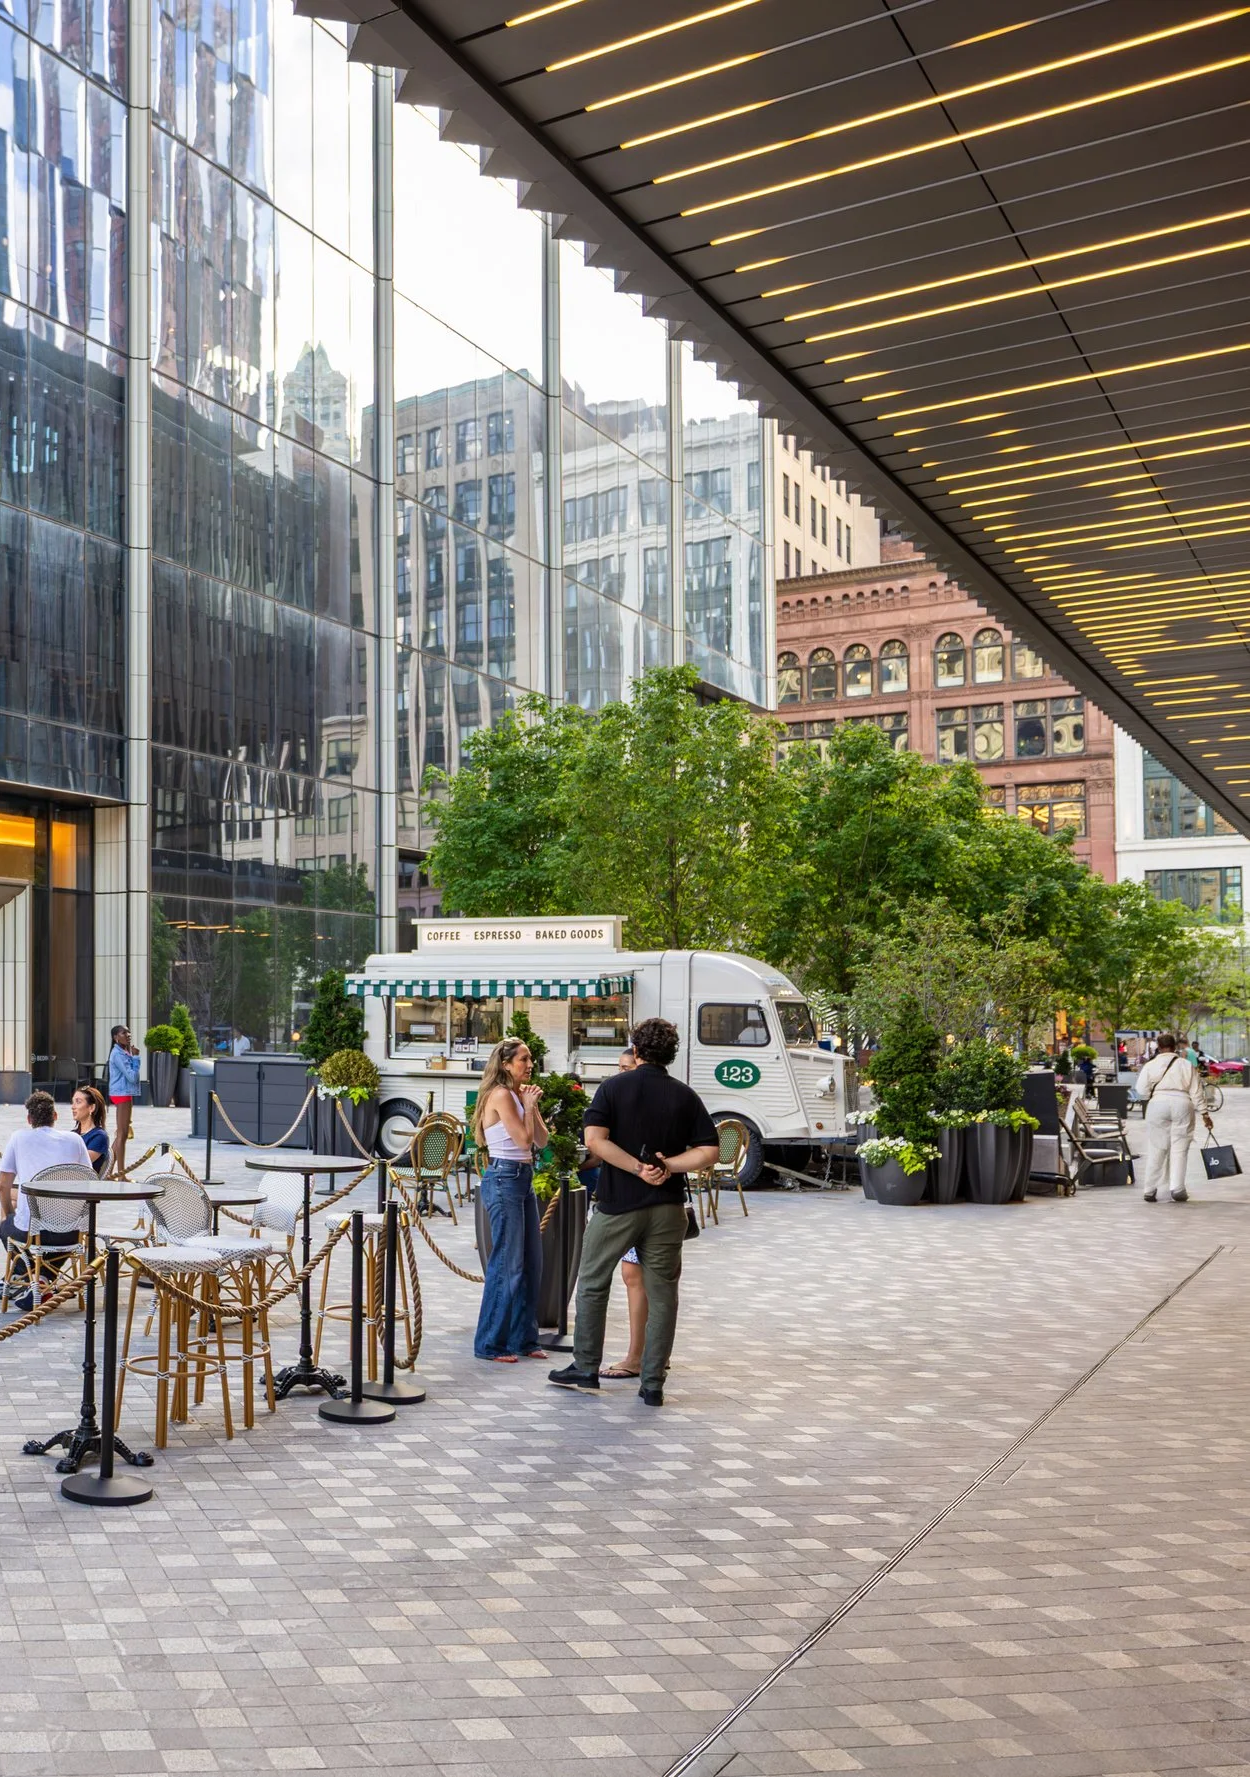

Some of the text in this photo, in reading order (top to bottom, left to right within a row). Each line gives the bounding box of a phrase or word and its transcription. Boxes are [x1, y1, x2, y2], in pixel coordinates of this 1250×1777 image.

[427, 929, 604, 941] COFFEE ESPRESSO BAKED GOODS
[722, 1066, 754, 1083] 123
